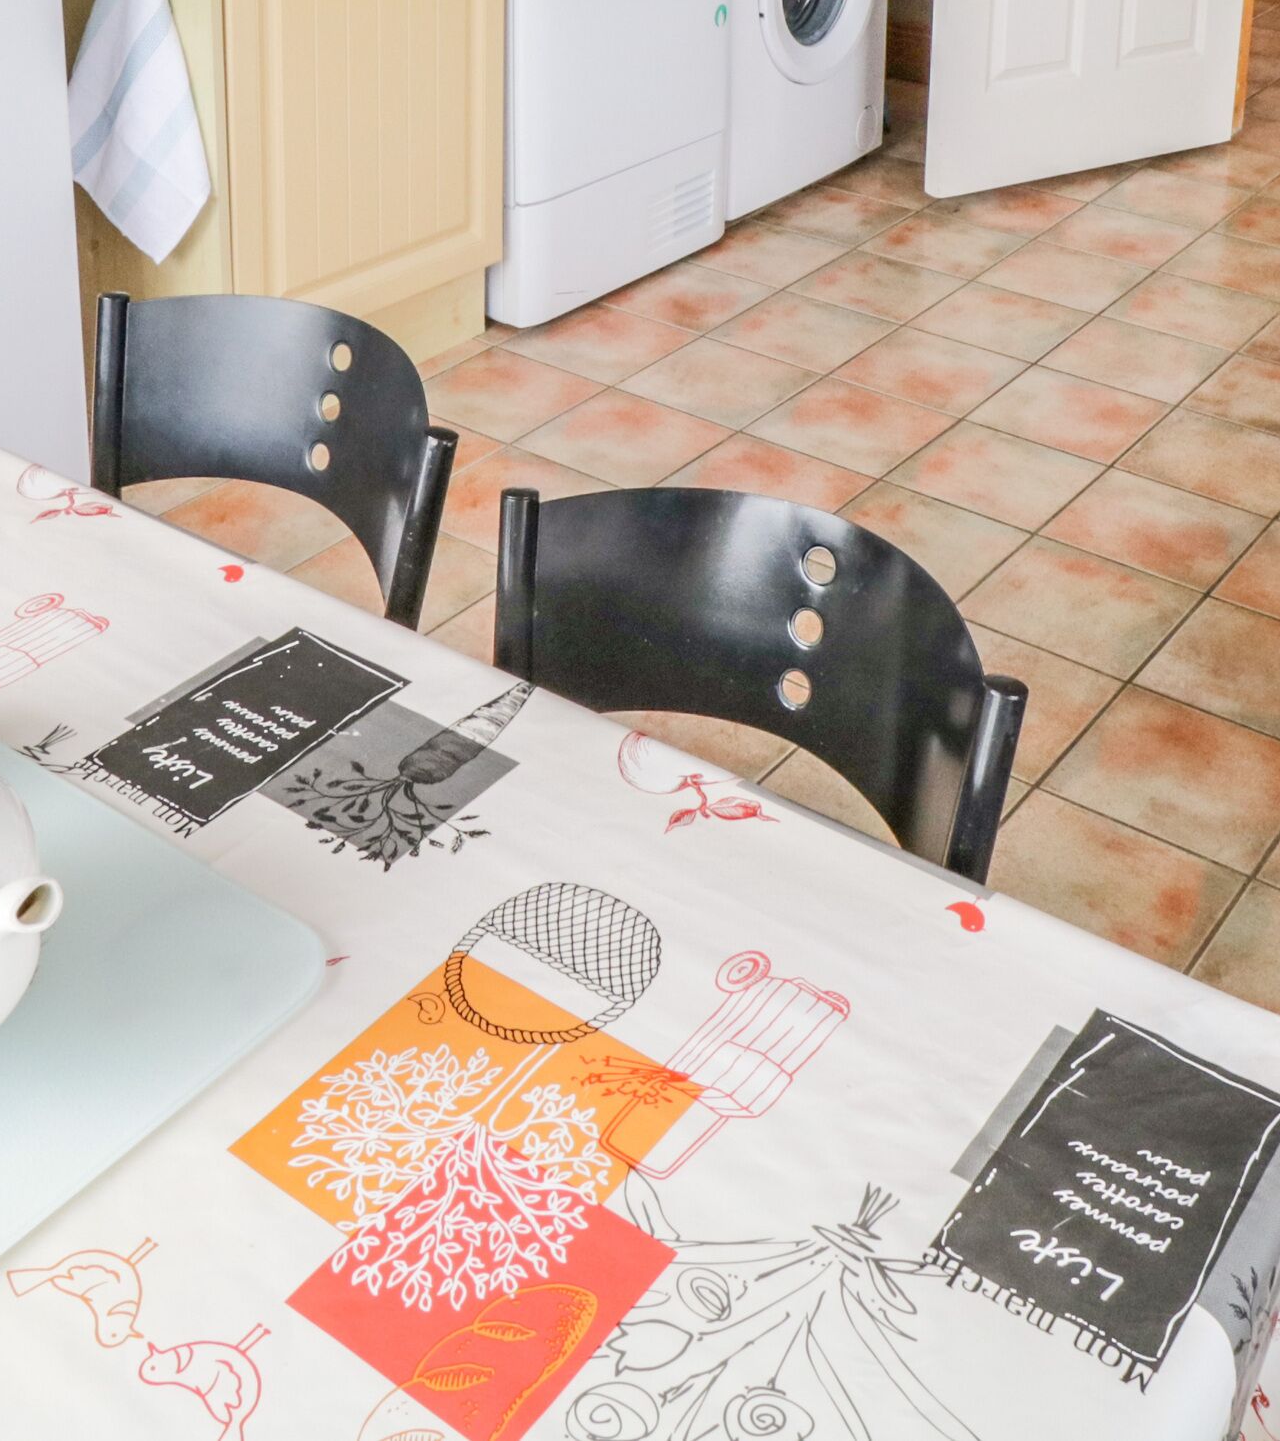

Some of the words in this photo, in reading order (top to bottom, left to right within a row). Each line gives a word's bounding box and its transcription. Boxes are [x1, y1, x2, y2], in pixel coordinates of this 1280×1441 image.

[216, 717, 279, 752] carottes
[222, 700, 300, 740] poireaux
[270, 705, 317, 729] pain
[192, 727, 263, 764] pommes
[151, 804, 202, 839] Mon
[1067, 1140, 1200, 1208] poireaux
[1136, 1149, 1211, 1187] pain
[1076, 1171, 1185, 1230] carottes
[1052, 1189, 1172, 1254] pommes
[1009, 1228, 1125, 1302] Liste
[1071, 1329, 1159, 1396] Mon
